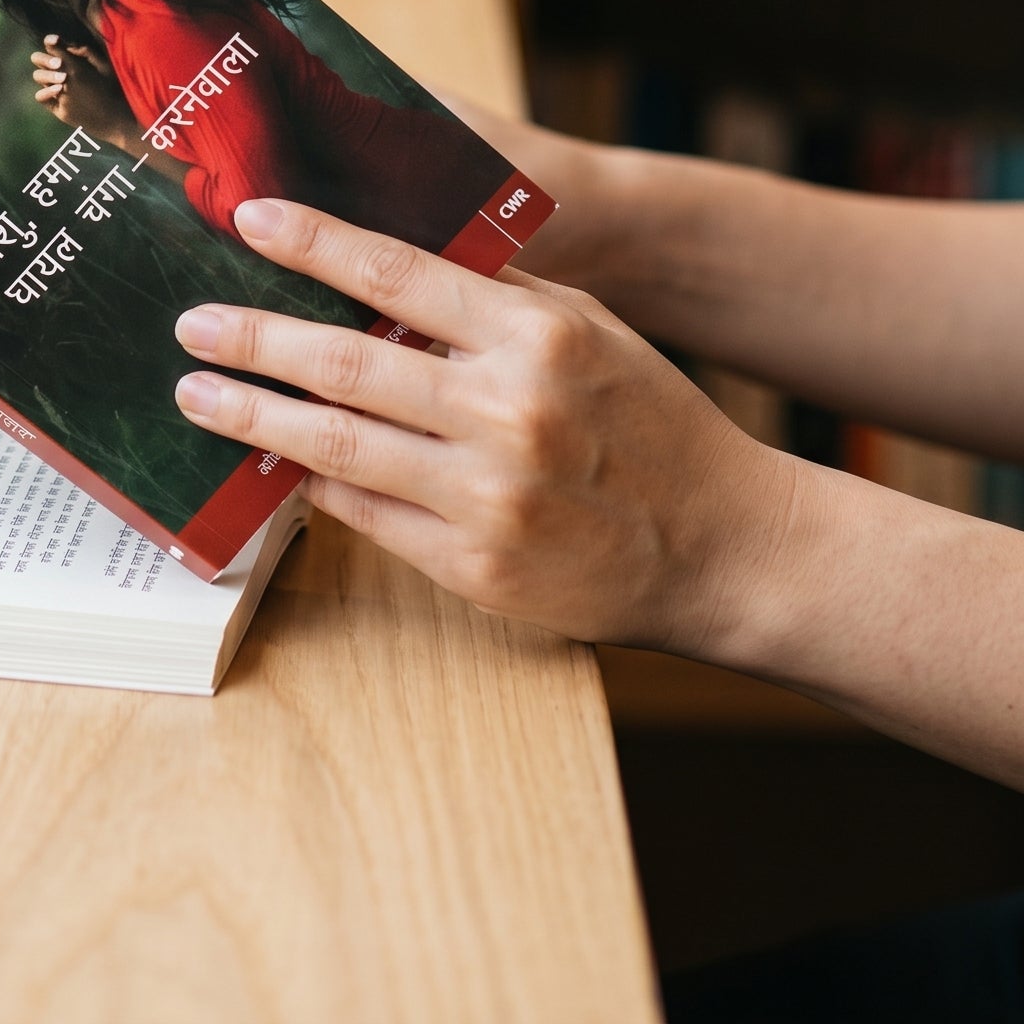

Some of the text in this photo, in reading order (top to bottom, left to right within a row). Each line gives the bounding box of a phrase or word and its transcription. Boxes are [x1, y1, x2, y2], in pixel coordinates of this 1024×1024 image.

[22, 125, 102, 208] हमारा
[499, 188, 531, 219] CWR
[4, 226, 84, 304] घायल
